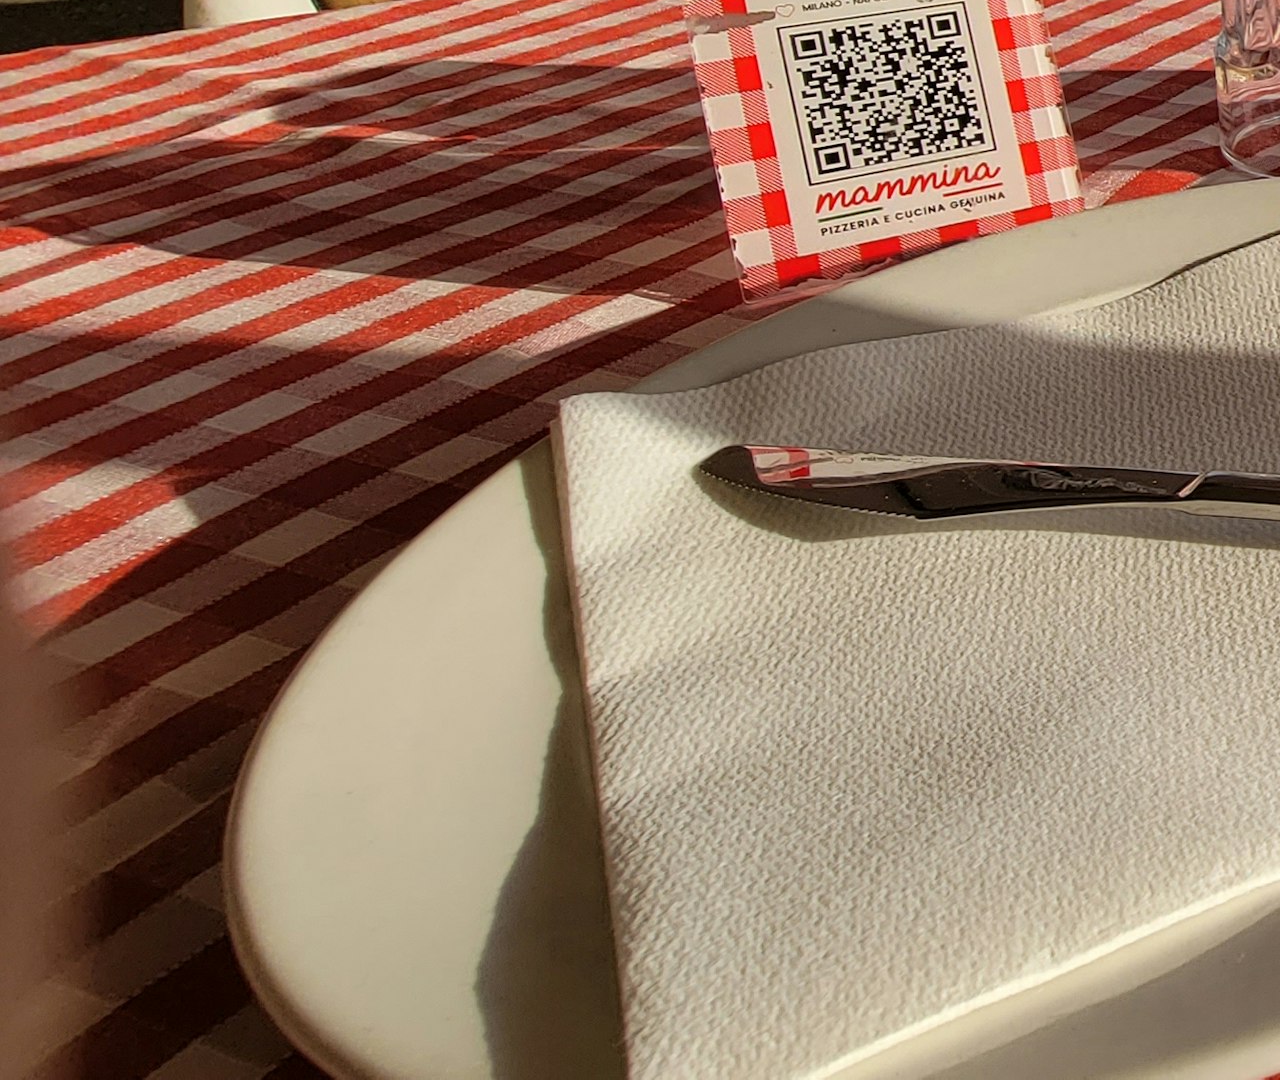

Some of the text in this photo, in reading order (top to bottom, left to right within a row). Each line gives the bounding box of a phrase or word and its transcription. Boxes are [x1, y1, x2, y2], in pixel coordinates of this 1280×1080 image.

[802, 0, 842, 12] MILANO
[815, 162, 1001, 214] mammina
[820, 217, 880, 237] PIZZERIA
[884, 215, 890, 223] E
[895, 203, 946, 221] CUCINA
